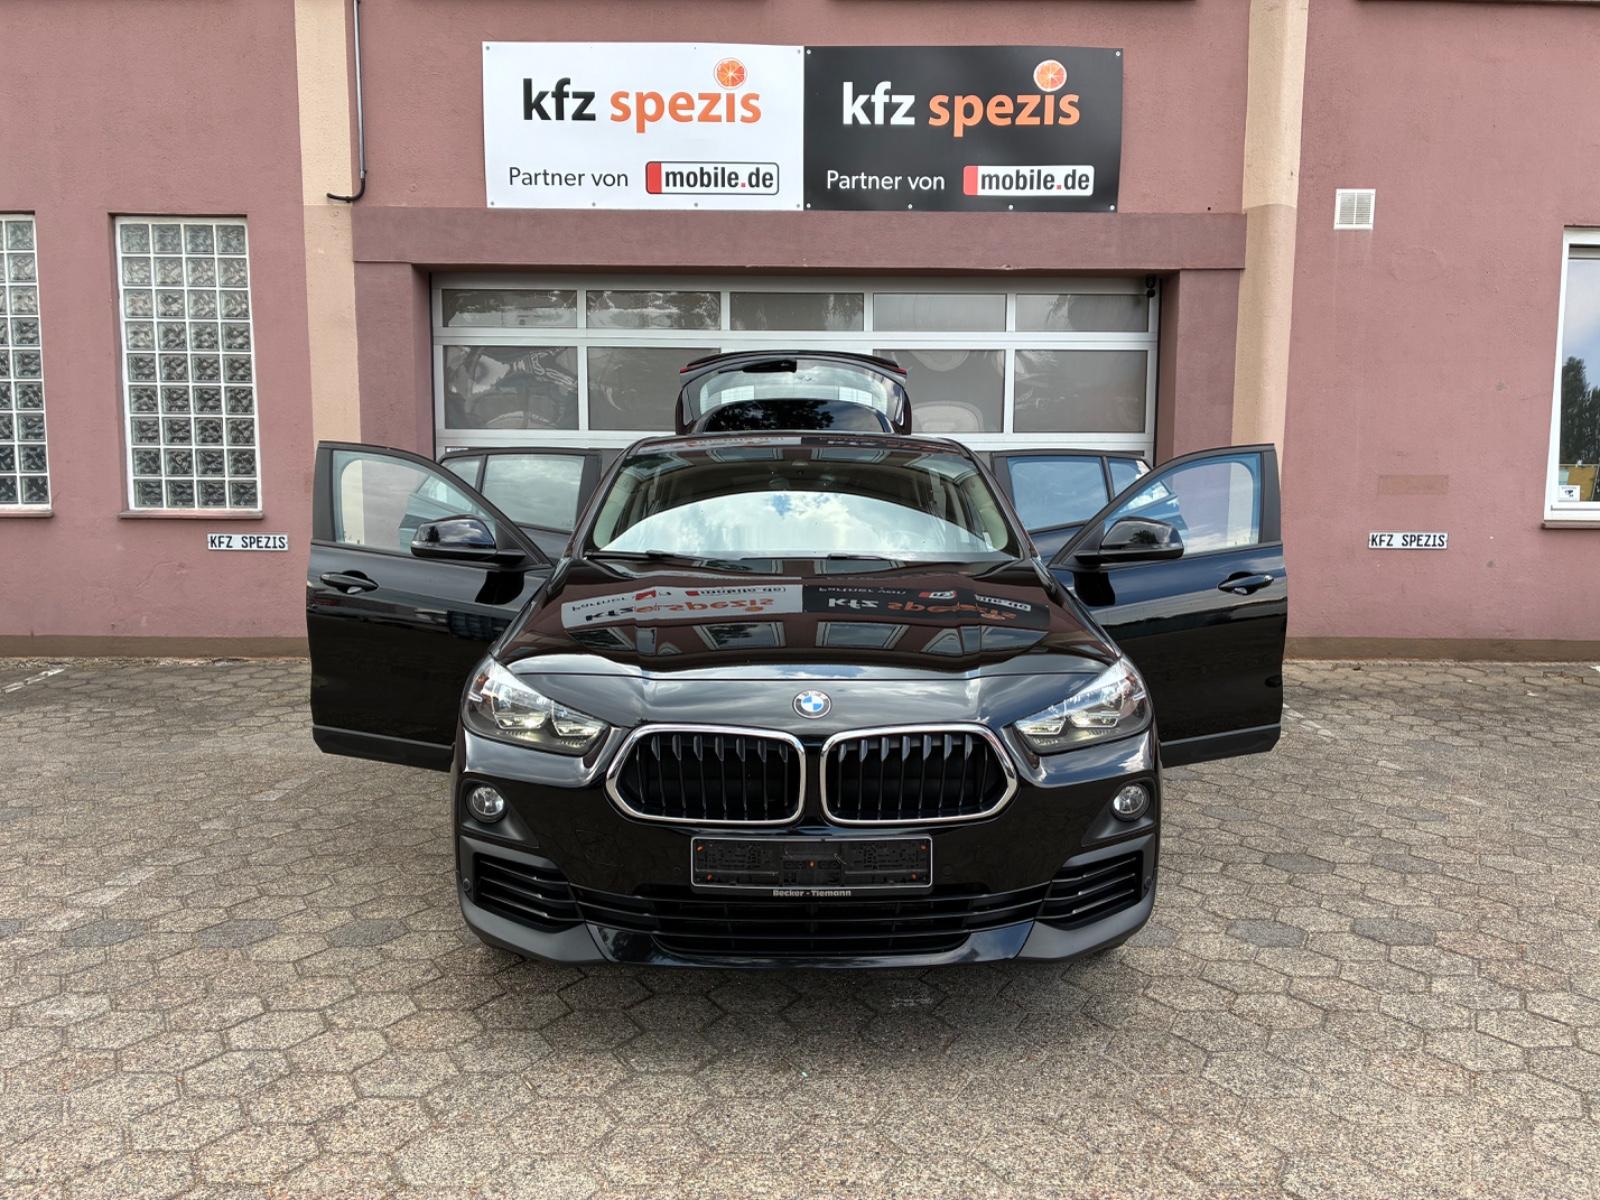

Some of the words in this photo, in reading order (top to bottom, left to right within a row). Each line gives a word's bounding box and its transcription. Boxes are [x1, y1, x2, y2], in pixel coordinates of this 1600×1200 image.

[523, 78, 596, 121] kfz
[610, 90, 762, 134] spezis
[843, 81, 916, 125] kfz
[928, 94, 1080, 138] spezis
[509, 167, 585, 187] Partner
[591, 173, 629, 187] von
[664, 166, 774, 188] mobile.de
[827, 170, 903, 190] Partner
[907, 175, 945, 190] von
[980, 169, 1090, 191] mobile.de
[210, 535, 233, 548] KFZ
[241, 536, 286, 549] SPEZIS
[1371, 534, 1394, 547] KFZ
[1401, 534, 1445, 547] SPEZIS
[772, 889, 804, 897] Becker
[810, 889, 852, 897] Tiemann
